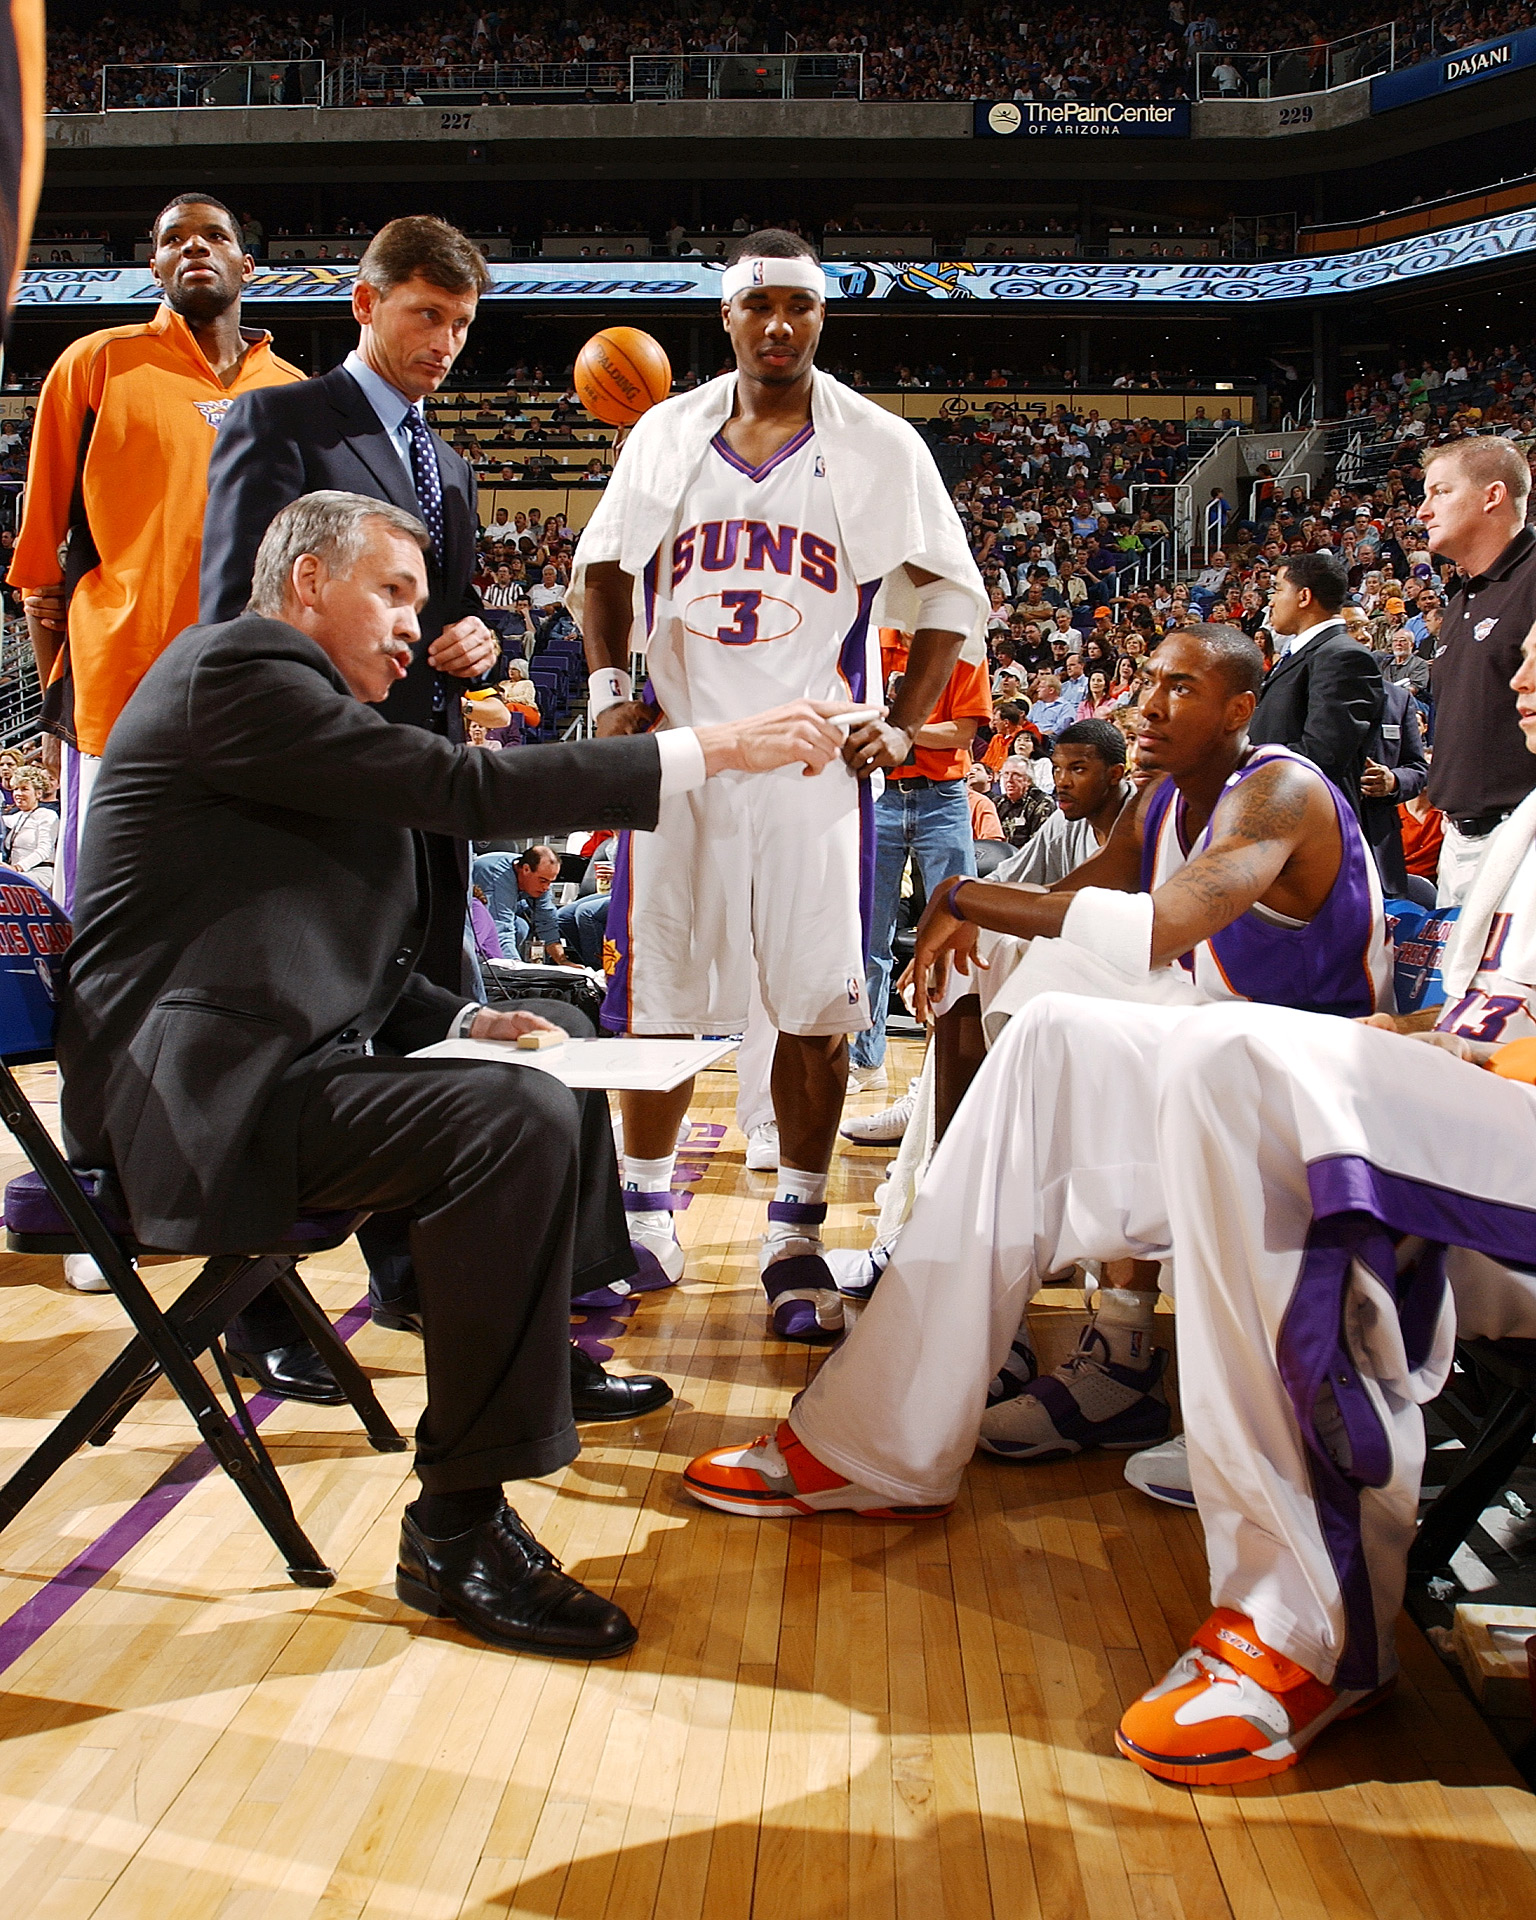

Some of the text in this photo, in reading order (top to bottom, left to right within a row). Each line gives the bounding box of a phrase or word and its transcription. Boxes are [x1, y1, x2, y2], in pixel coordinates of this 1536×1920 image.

[1448, 46, 1508, 80] DASANI
[441, 113, 472, 130] 227
[1024, 103, 1176, 122] ThePainCenter
[1279, 106, 1313, 125] 229
[1028, 125, 1121, 135] OF ARIZONA
[968, 211, 1536, 279] TICKET INFORMATIO
[971, 401, 1047, 412] LEXUS
[671, 518, 838, 593] SUNS
[717, 589, 763, 645] 3
[27, 921, 74, 956] GAM
[1431, 988, 1527, 1043] 13
